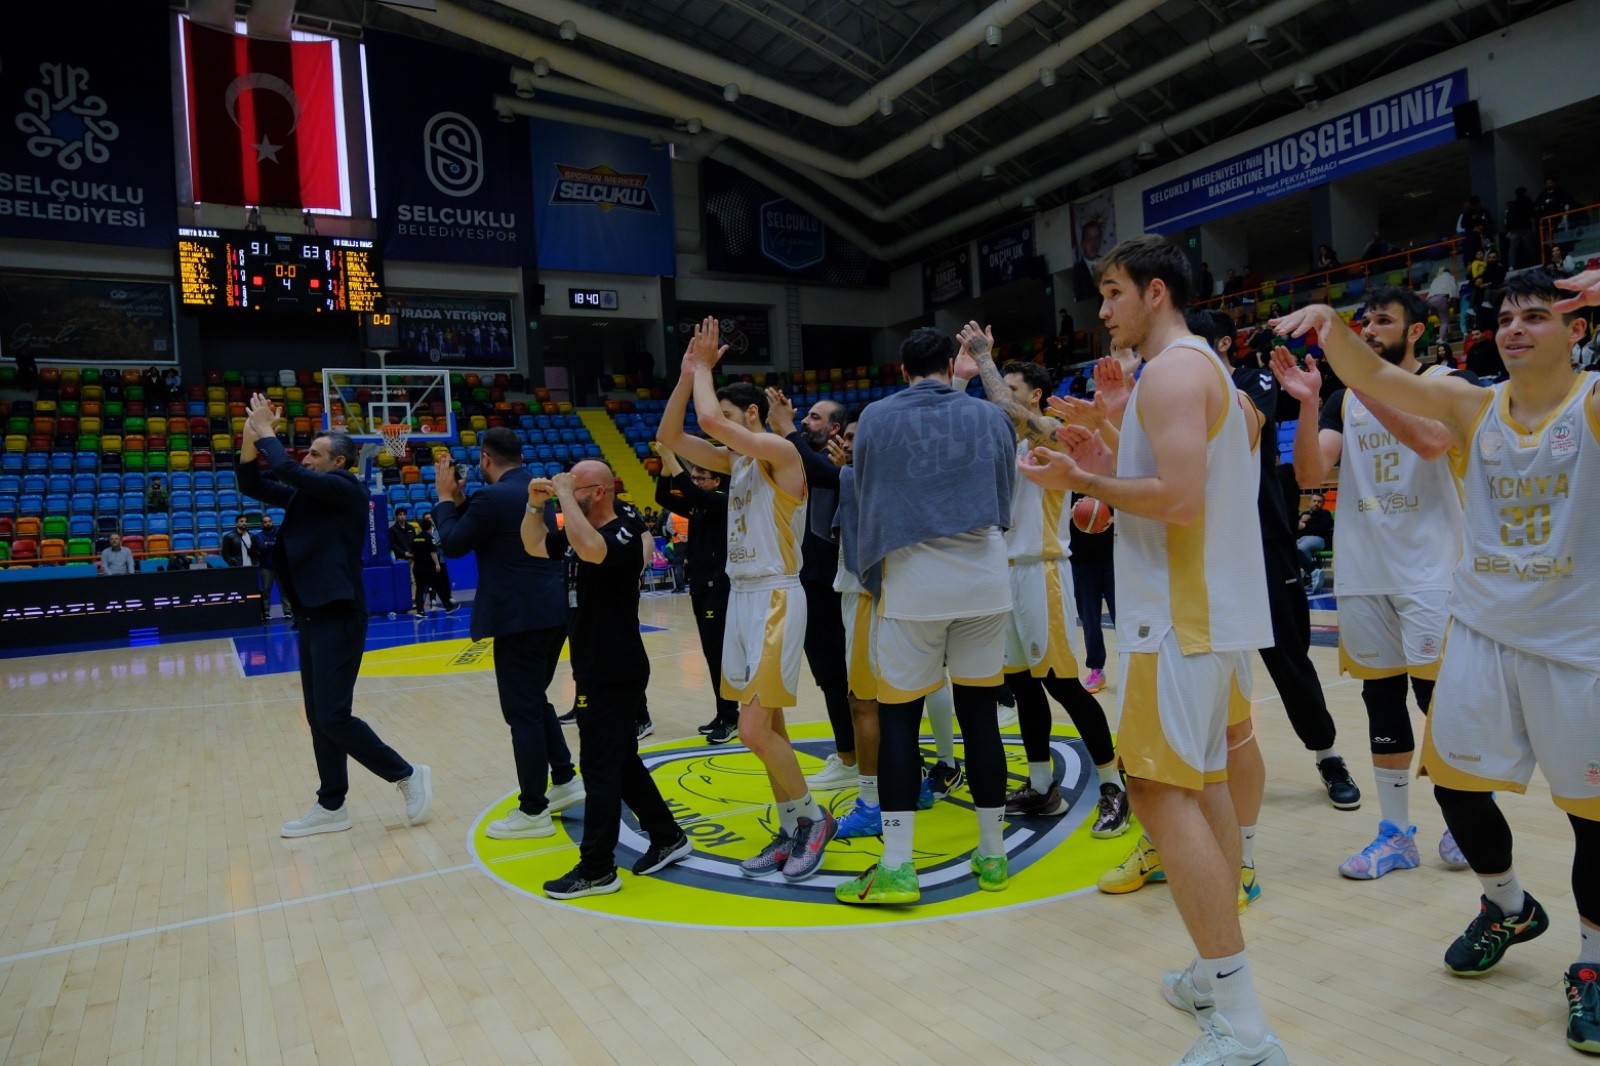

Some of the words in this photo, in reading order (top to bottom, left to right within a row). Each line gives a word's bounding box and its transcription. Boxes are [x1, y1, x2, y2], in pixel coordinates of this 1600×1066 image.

[564, 171, 602, 182] SPORUN
[0, 172, 144, 205] SELÇUKLU
[1150, 180, 1190, 205] SELÇUKLU
[1255, 181, 1279, 195] Ahmet
[0, 198, 146, 228] BELEDİYESİ
[251, 242, 268, 254] 91
[303, 246, 319, 258] 63
[283, 278, 291, 290] 4
[1373, 452, 1399, 484] 12
[1487, 473, 1569, 499] KONYA
[1500, 504, 1550, 546] 20
[883, 819, 901, 827] 23
